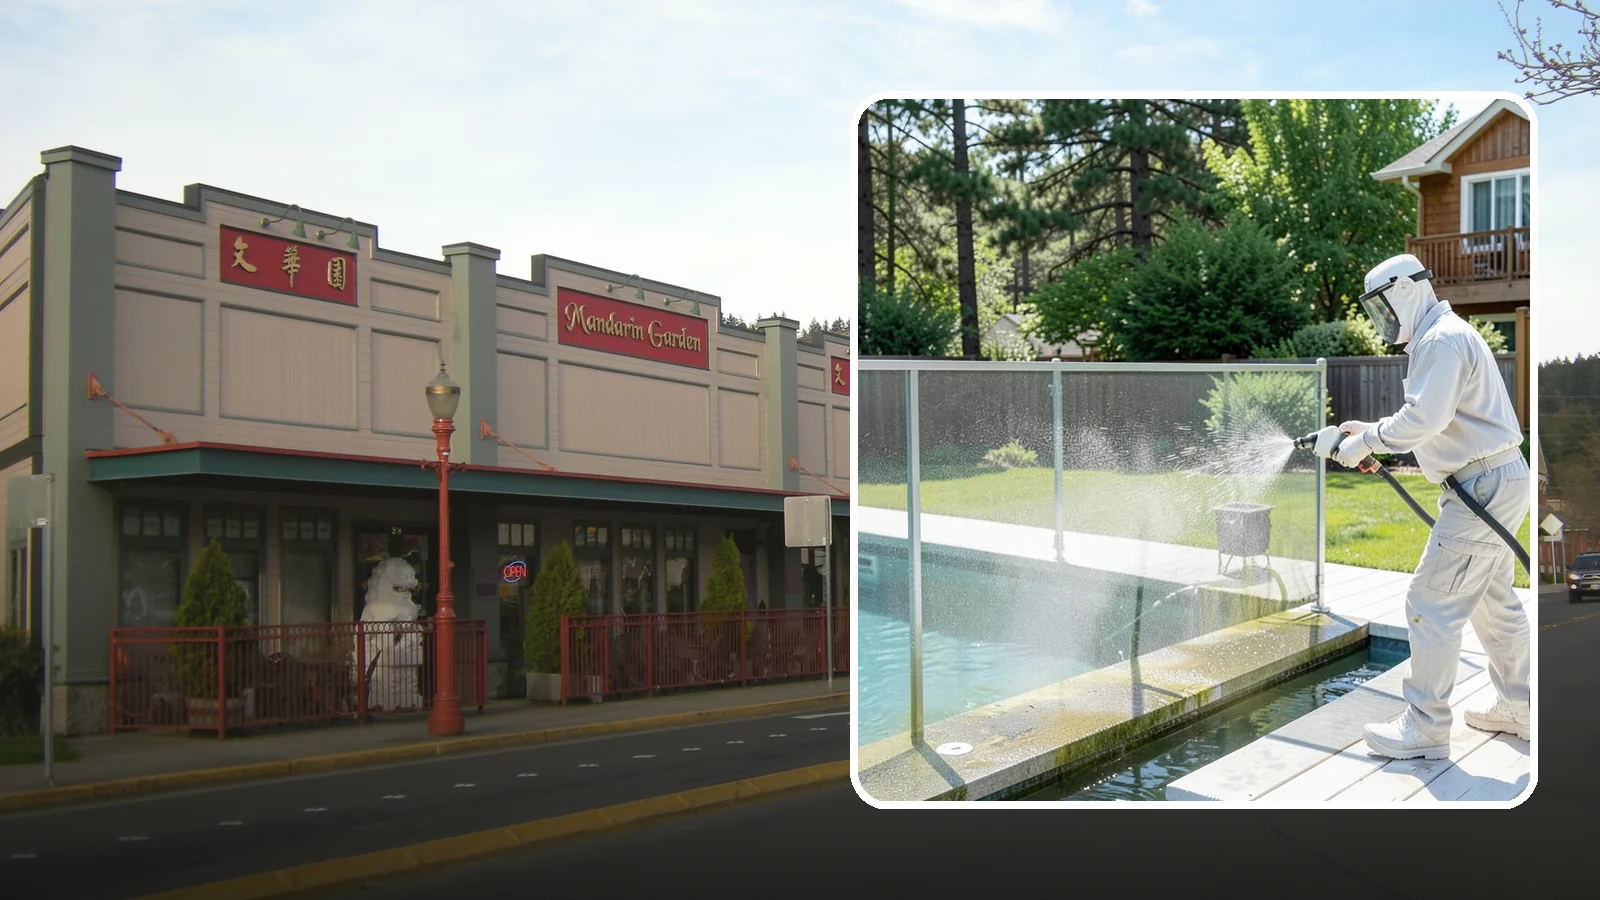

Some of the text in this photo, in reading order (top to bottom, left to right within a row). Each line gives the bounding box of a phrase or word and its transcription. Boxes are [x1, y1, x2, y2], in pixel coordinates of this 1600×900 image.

[231, 235, 346, 291] 文華園
[564, 302, 701, 352] Mandarin Garden
[503, 565, 527, 578] OPEN
